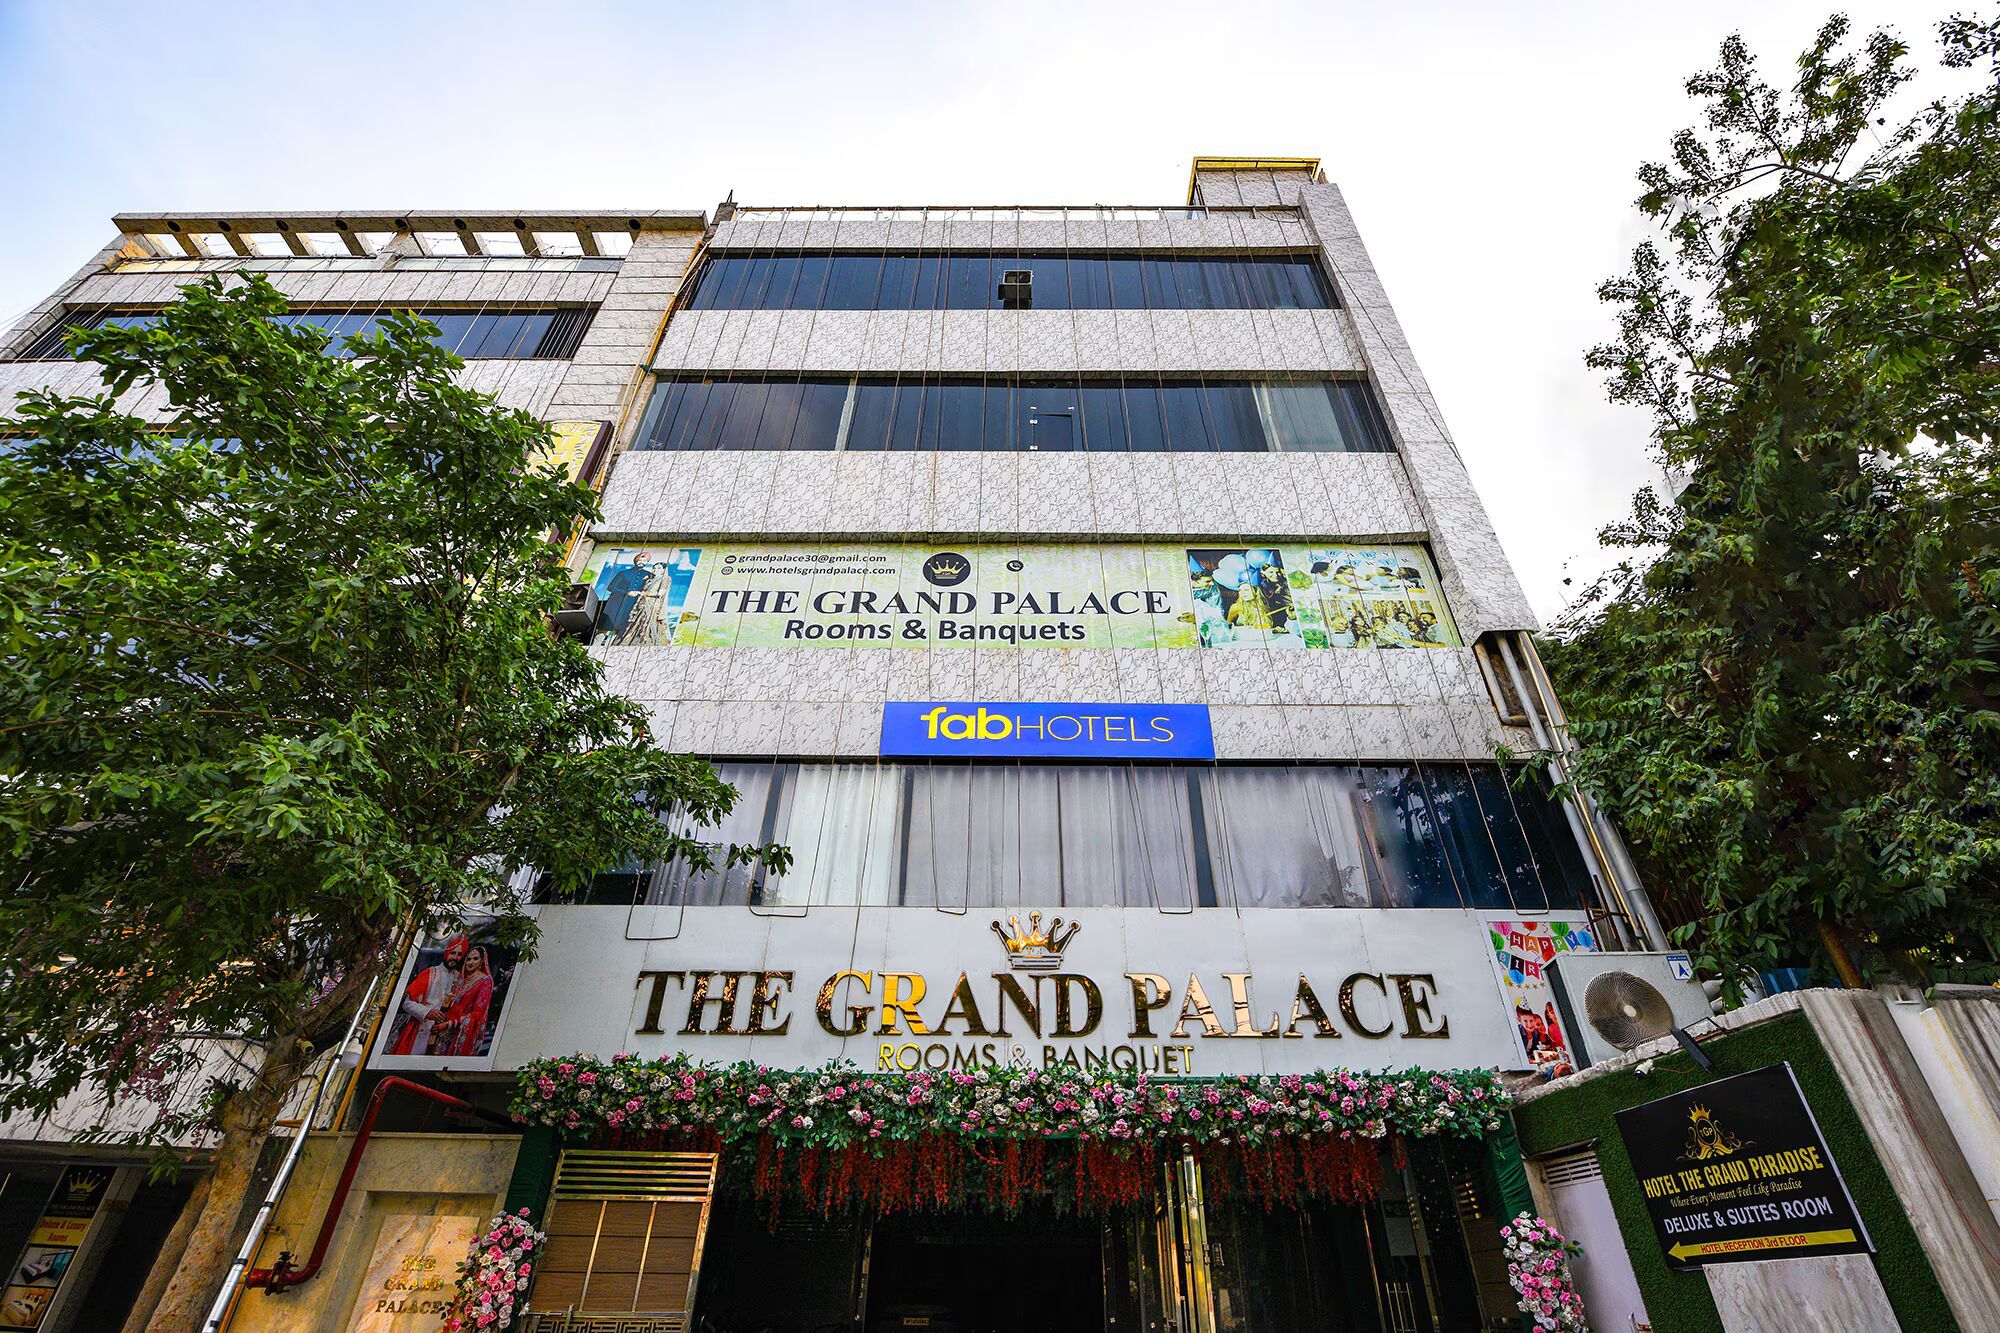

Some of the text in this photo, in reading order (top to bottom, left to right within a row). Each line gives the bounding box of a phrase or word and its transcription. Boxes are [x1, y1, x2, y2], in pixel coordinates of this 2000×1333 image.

[737, 566, 896, 575] www.hotelsgrandpalace.com
[738, 554, 887, 563] grandpalace30@gmail.com
[711, 590, 1171, 615] THE GRAND PALACE
[784, 619, 1086, 645] Rooms & Banquets
[1512, 934, 1577, 950] HAPPY
[635, 970, 1451, 1039] THE GRAND PALACE
[879, 1043, 1195, 1074] ROOMS & BANQUET
[1643, 1146, 1824, 1198] HOTEL THE GRAND PARADISE
[1708, 1190, 1736, 1202] Moment
[1736, 1183, 1753, 1197] Feel
[1753, 1181, 1770, 1196] Like
[1770, 1177, 1803, 1193] Paradise
[1664, 1196, 1834, 1234] DELUXE & SUITES ROOM
[1700, 1234, 1809, 1254] HOTEL RECEPTION 3rd FLOOR
[384, 1276, 445, 1291] GRAND
[375, 1300, 443, 1314] PALACE
